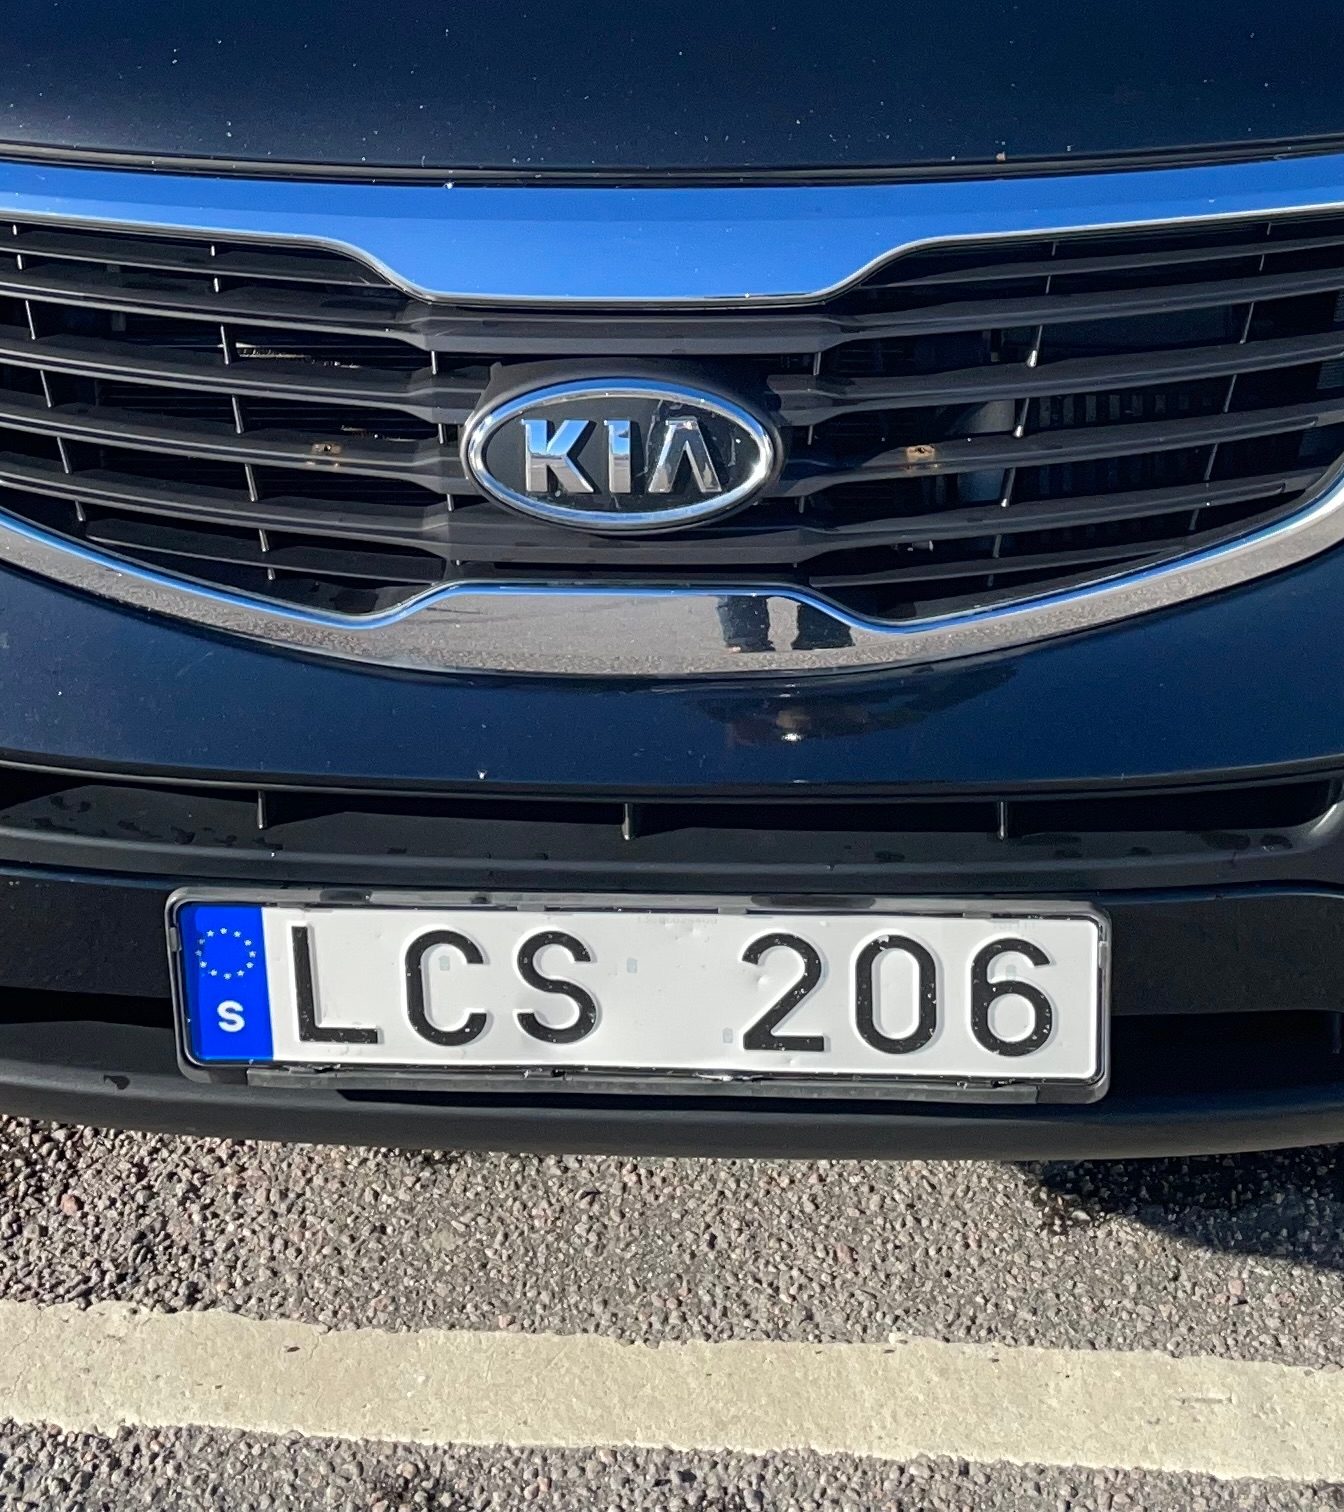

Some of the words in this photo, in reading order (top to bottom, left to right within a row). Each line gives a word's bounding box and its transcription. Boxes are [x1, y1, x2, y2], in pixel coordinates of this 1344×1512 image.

[522, 419, 722, 493] KIA
[216, 999, 246, 1033] S
[290, 926, 598, 1048] LCS
[741, 931, 1054, 1057] 206
